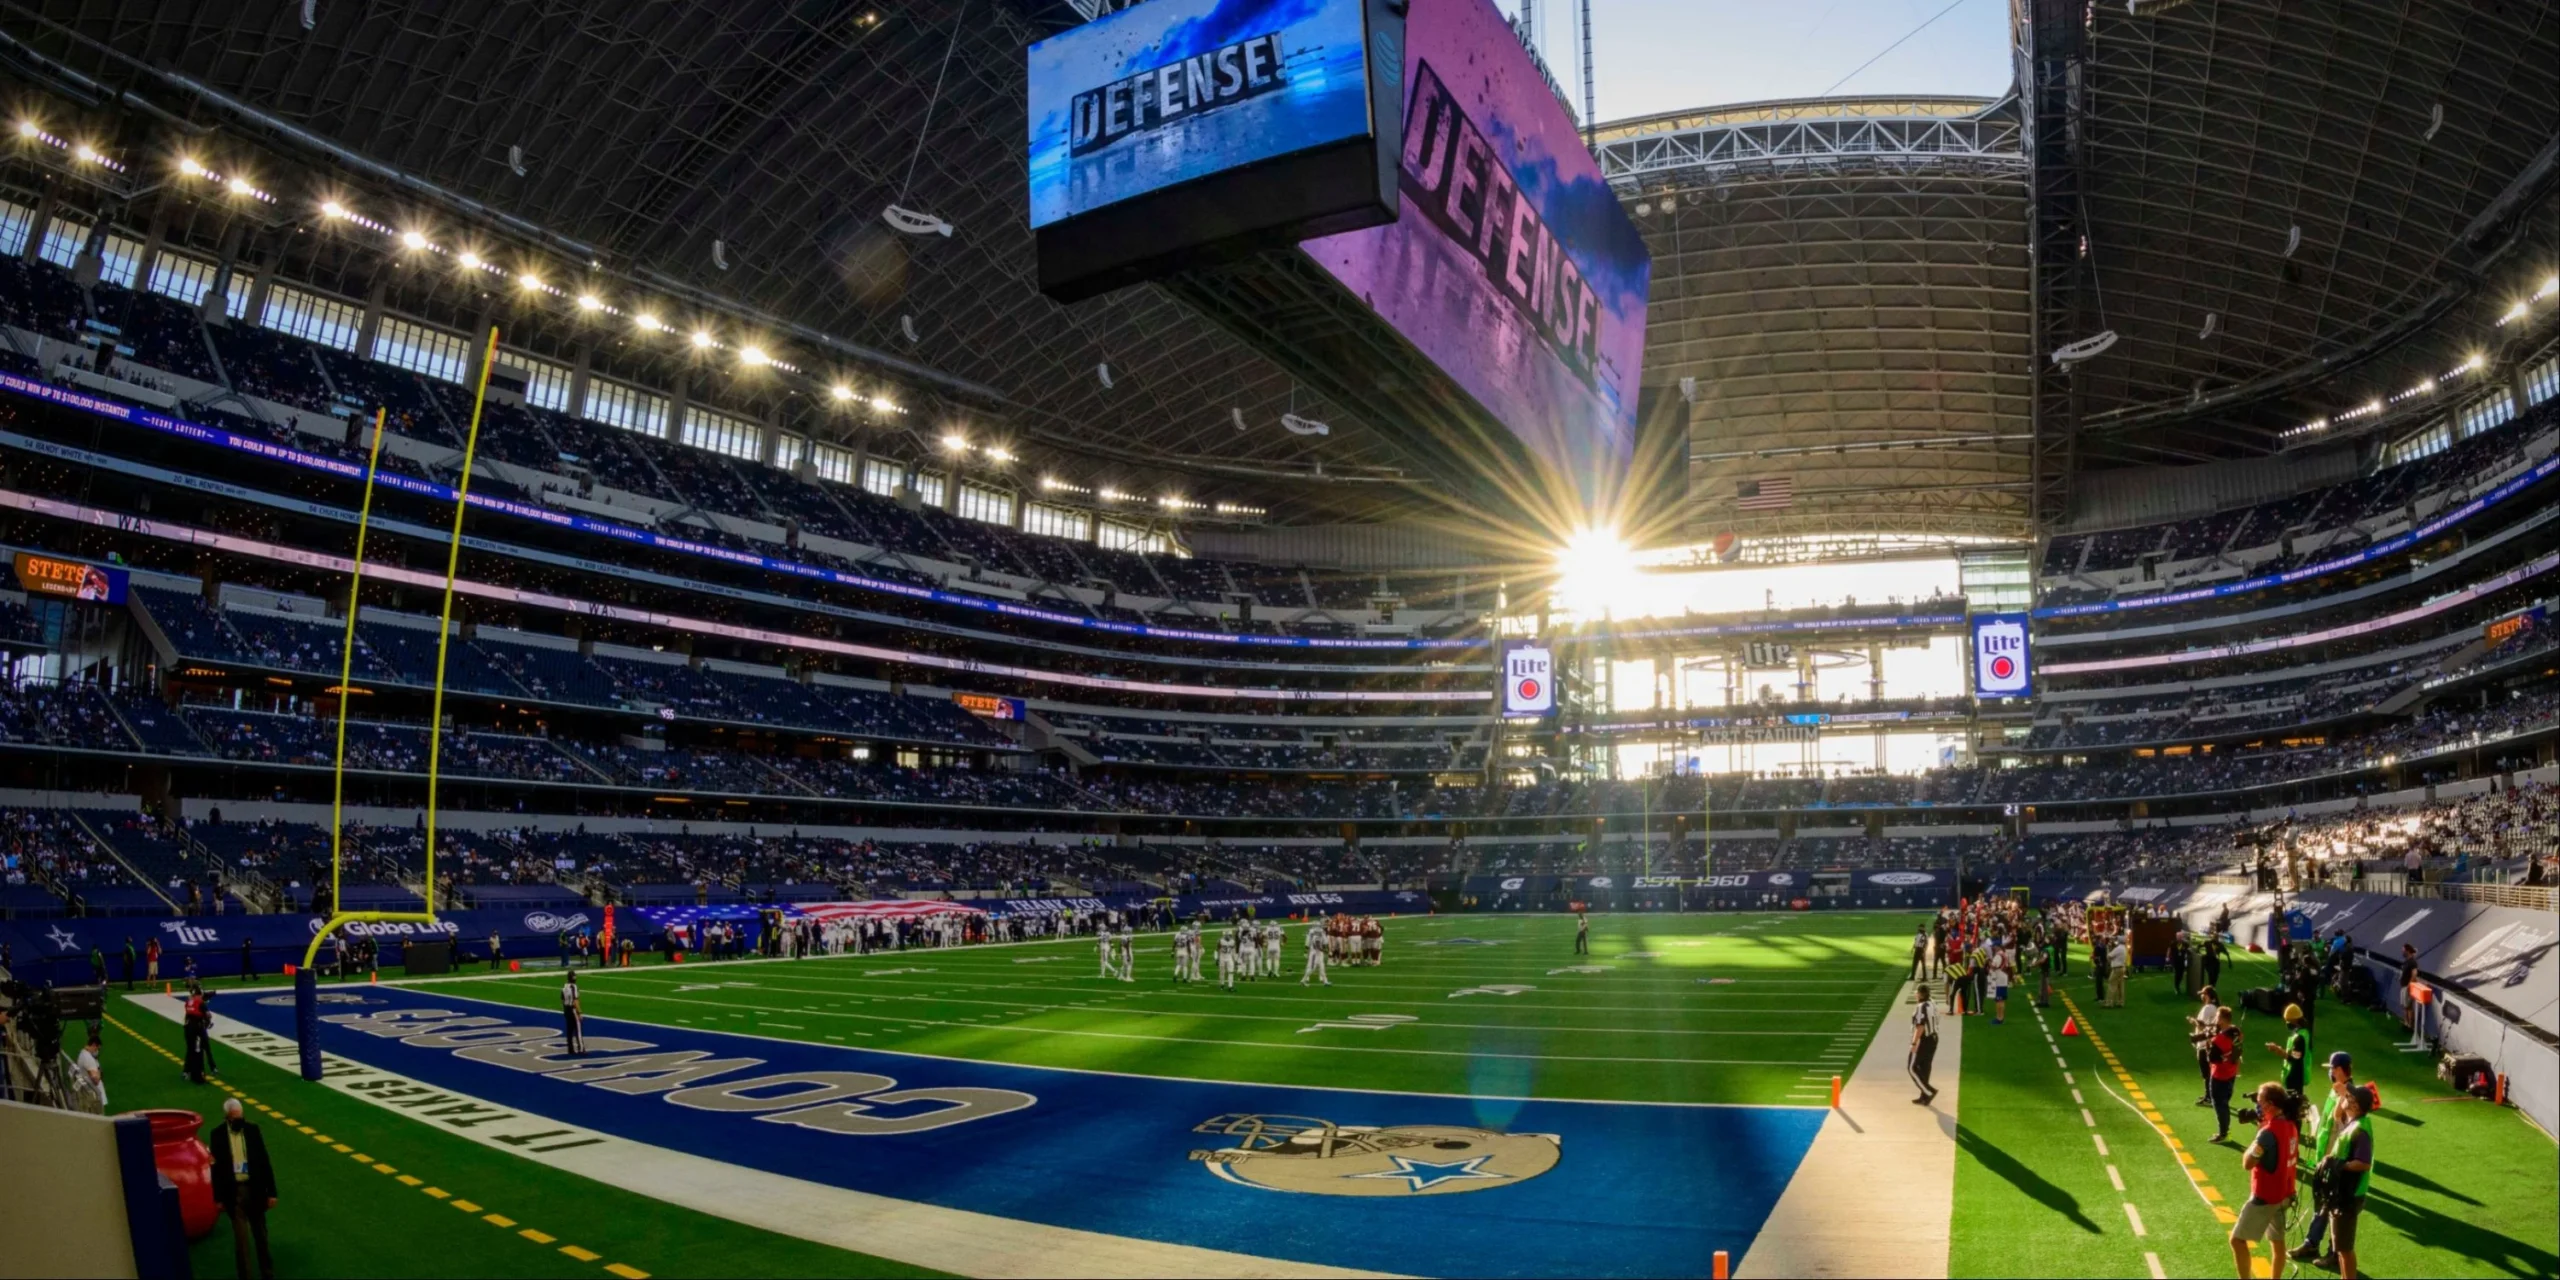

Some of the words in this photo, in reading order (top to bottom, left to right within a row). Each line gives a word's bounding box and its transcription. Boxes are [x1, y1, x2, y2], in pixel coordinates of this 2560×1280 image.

[1073, 32, 1285, 146] DEFENSE!
[1403, 64, 1601, 377] DEFENSE!
[5, 376, 25, 390] COULD
[27, 381, 40, 394] WIN
[42, 385, 50, 397] UP
[52, 388, 60, 400] TO
[61, 448, 81, 460] WHITE
[228, 436, 241, 447] YOU
[242, 439, 262, 452] COULD
[264, 444, 276, 456] WIN
[278, 448, 286, 458] UP
[288, 450, 296, 461] TO
[327, 460, 360, 477] INSTANTLY!
[452, 490, 462, 500] YO
[465, 494, 482, 505] COULD
[484, 498, 495, 508] WIN
[496, 501, 504, 510] UP
[506, 503, 513, 512] TO
[118, 514, 152, 534] WAS
[654, 536, 665, 545] YOU
[666, 539, 682, 549] COULD
[684, 542, 694, 551] WIN
[695, 545, 702, 553] UP
[703, 546, 710, 554] TO
[42, 582, 77, 593] LEGENDARY
[588, 602, 616, 618] WAS
[1984, 634, 2020, 656] Lite
[963, 660, 986, 672] WAS
[1512, 658, 1548, 677] Lite
[1294, 691, 1318, 700] WAS
[1702, 730, 1740, 745] AT&T
[1744, 727, 1818, 744] STADIUM
[1632, 876, 1681, 888] EST
[1694, 874, 1750, 888] 1960
[1006, 899, 1067, 911] THANK
[1066, 898, 1106, 909] YOU
[1288, 894, 1322, 904] AT&T
[1321, 893, 1343, 904] 5G
[176, 926, 220, 946] Lite
[345, 918, 414, 936] Globe
[417, 918, 460, 934] Life
[220, 1032, 276, 1044] US
[248, 1046, 301, 1057] OF
[317, 1008, 1038, 1136] COWBOYS
[346, 1078, 517, 1128] TAKES
[490, 1128, 606, 1154] IT
